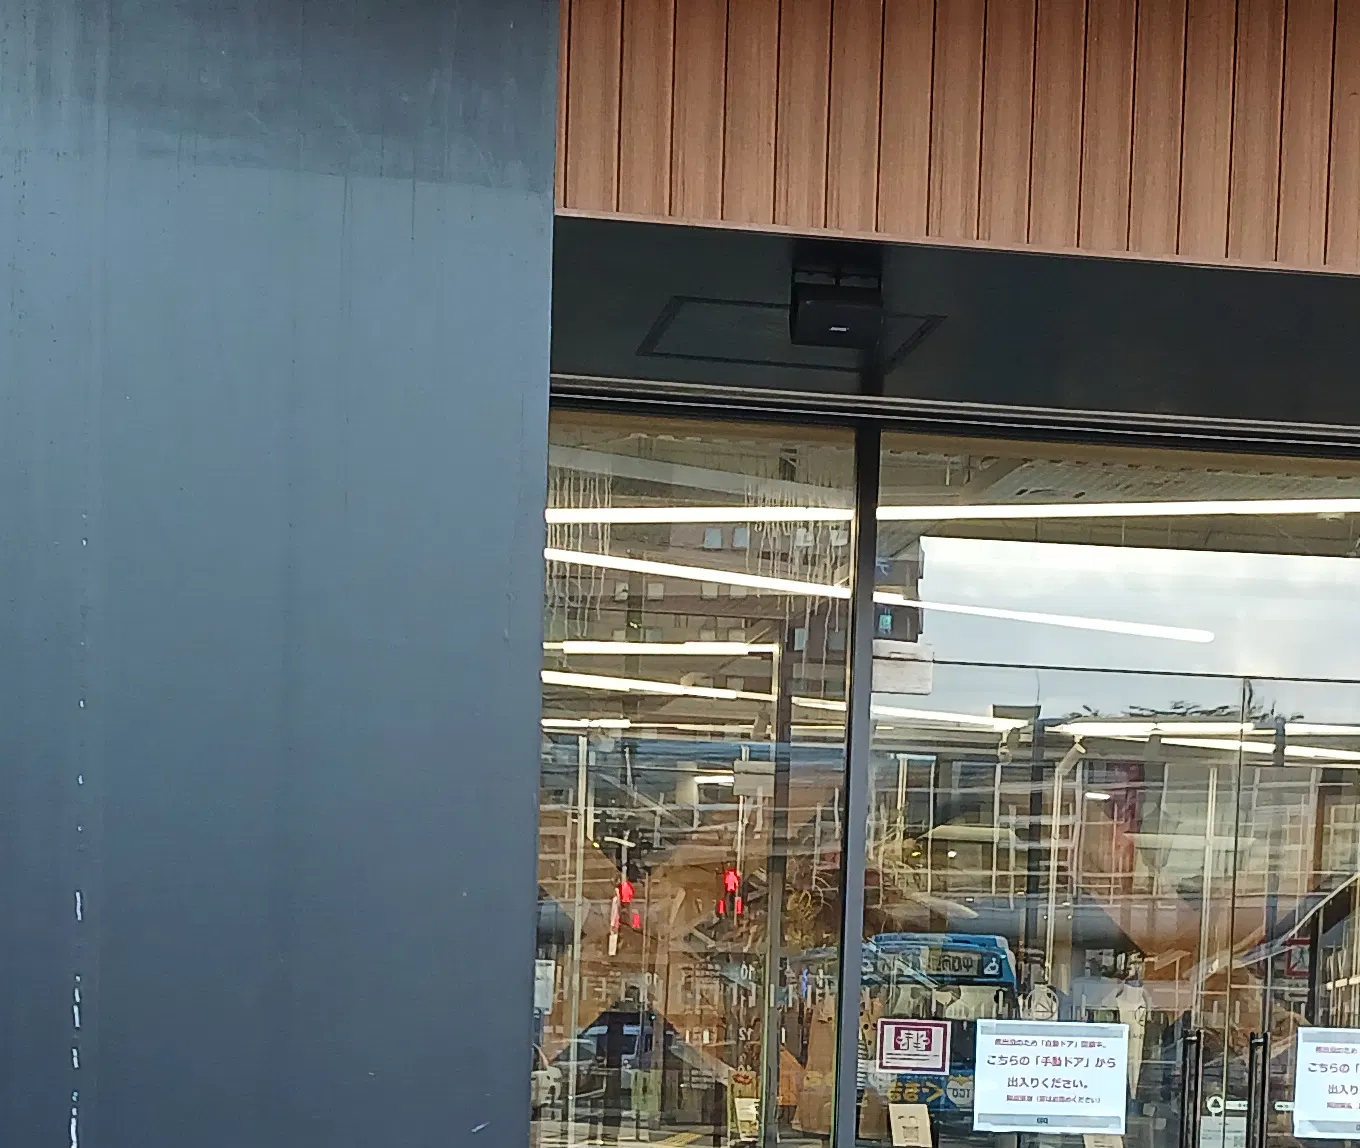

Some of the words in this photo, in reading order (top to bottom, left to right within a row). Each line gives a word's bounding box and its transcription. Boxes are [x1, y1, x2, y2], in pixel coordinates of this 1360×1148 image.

[986, 1055, 1117, 1069] こちらの「手動ドア」から
[1007, 1076, 1089, 1090] 出入りください。
